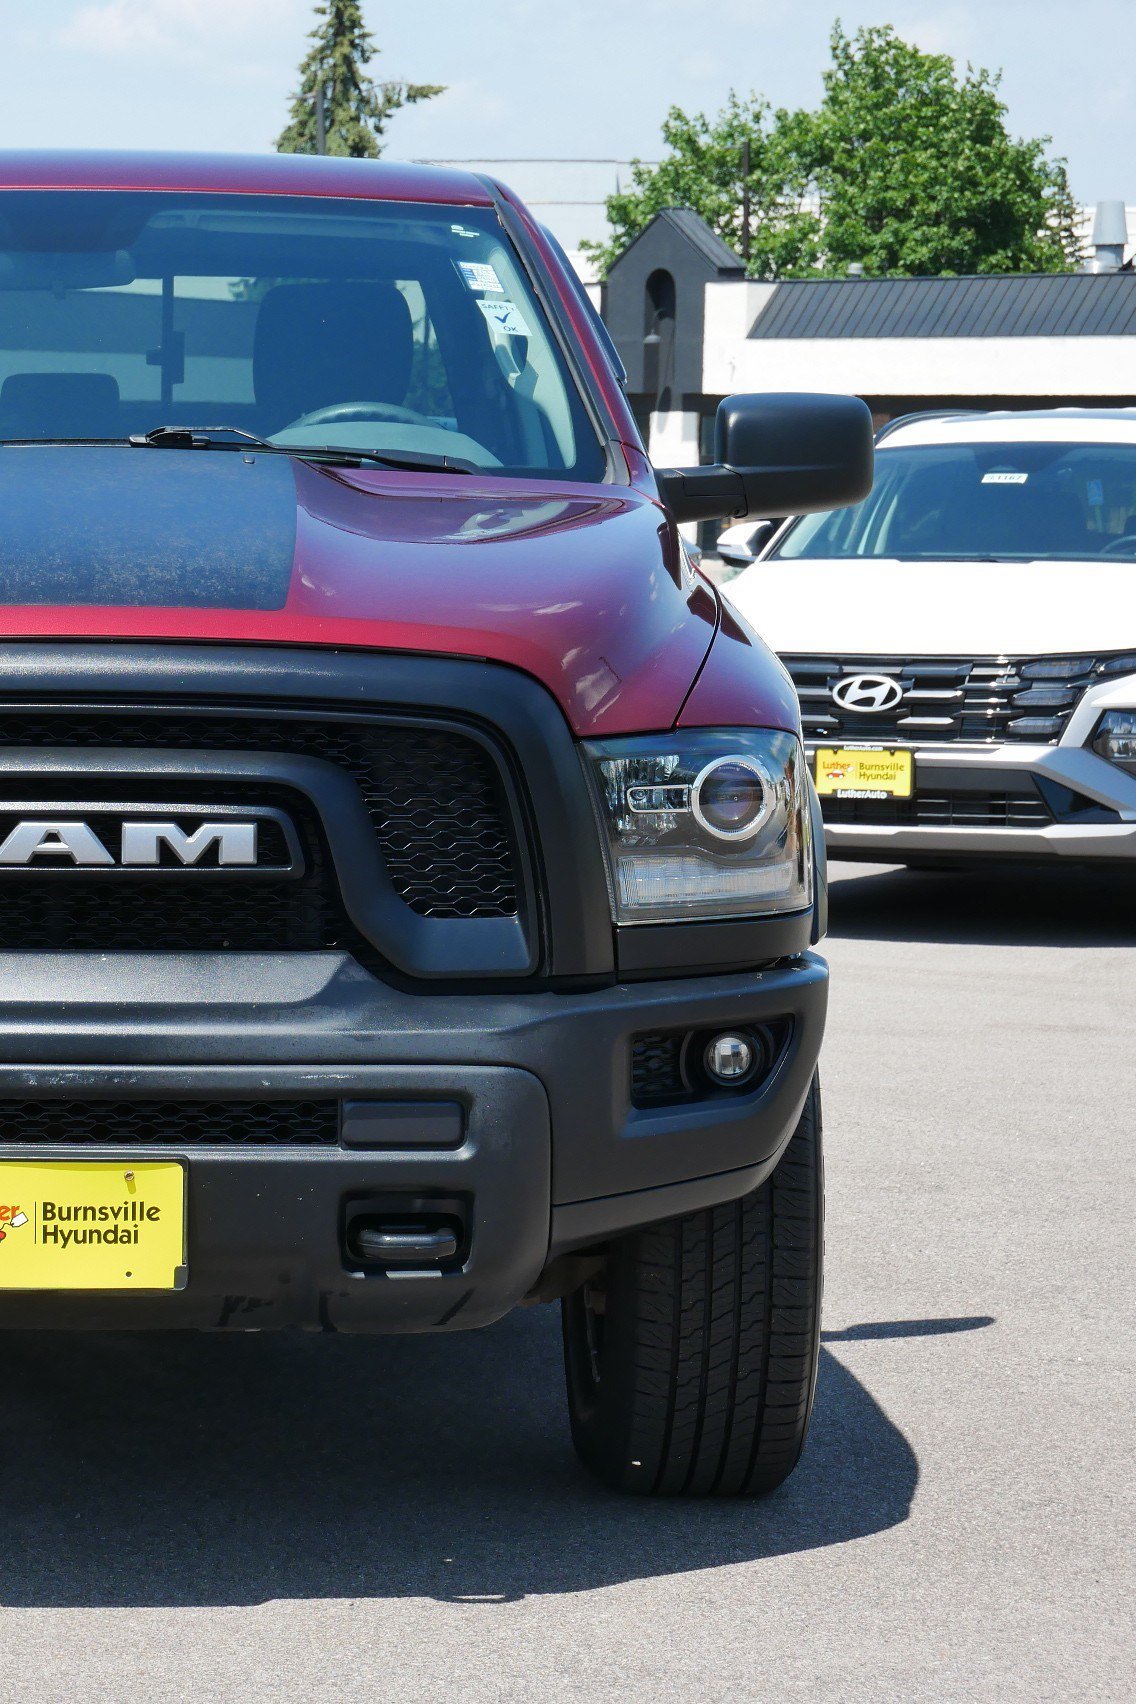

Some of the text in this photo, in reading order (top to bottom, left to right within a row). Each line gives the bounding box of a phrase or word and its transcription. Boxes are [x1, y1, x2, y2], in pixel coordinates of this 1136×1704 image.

[503, 325, 519, 333] OK
[822, 761, 851, 770] Luther
[859, 762, 905, 772] Burnsville
[859, 772, 896, 781] Hyundai
[837, 788, 888, 799] LutherAuto
[42, 1201, 161, 1222] Burnsville
[42, 1224, 139, 1249] Hyundai
